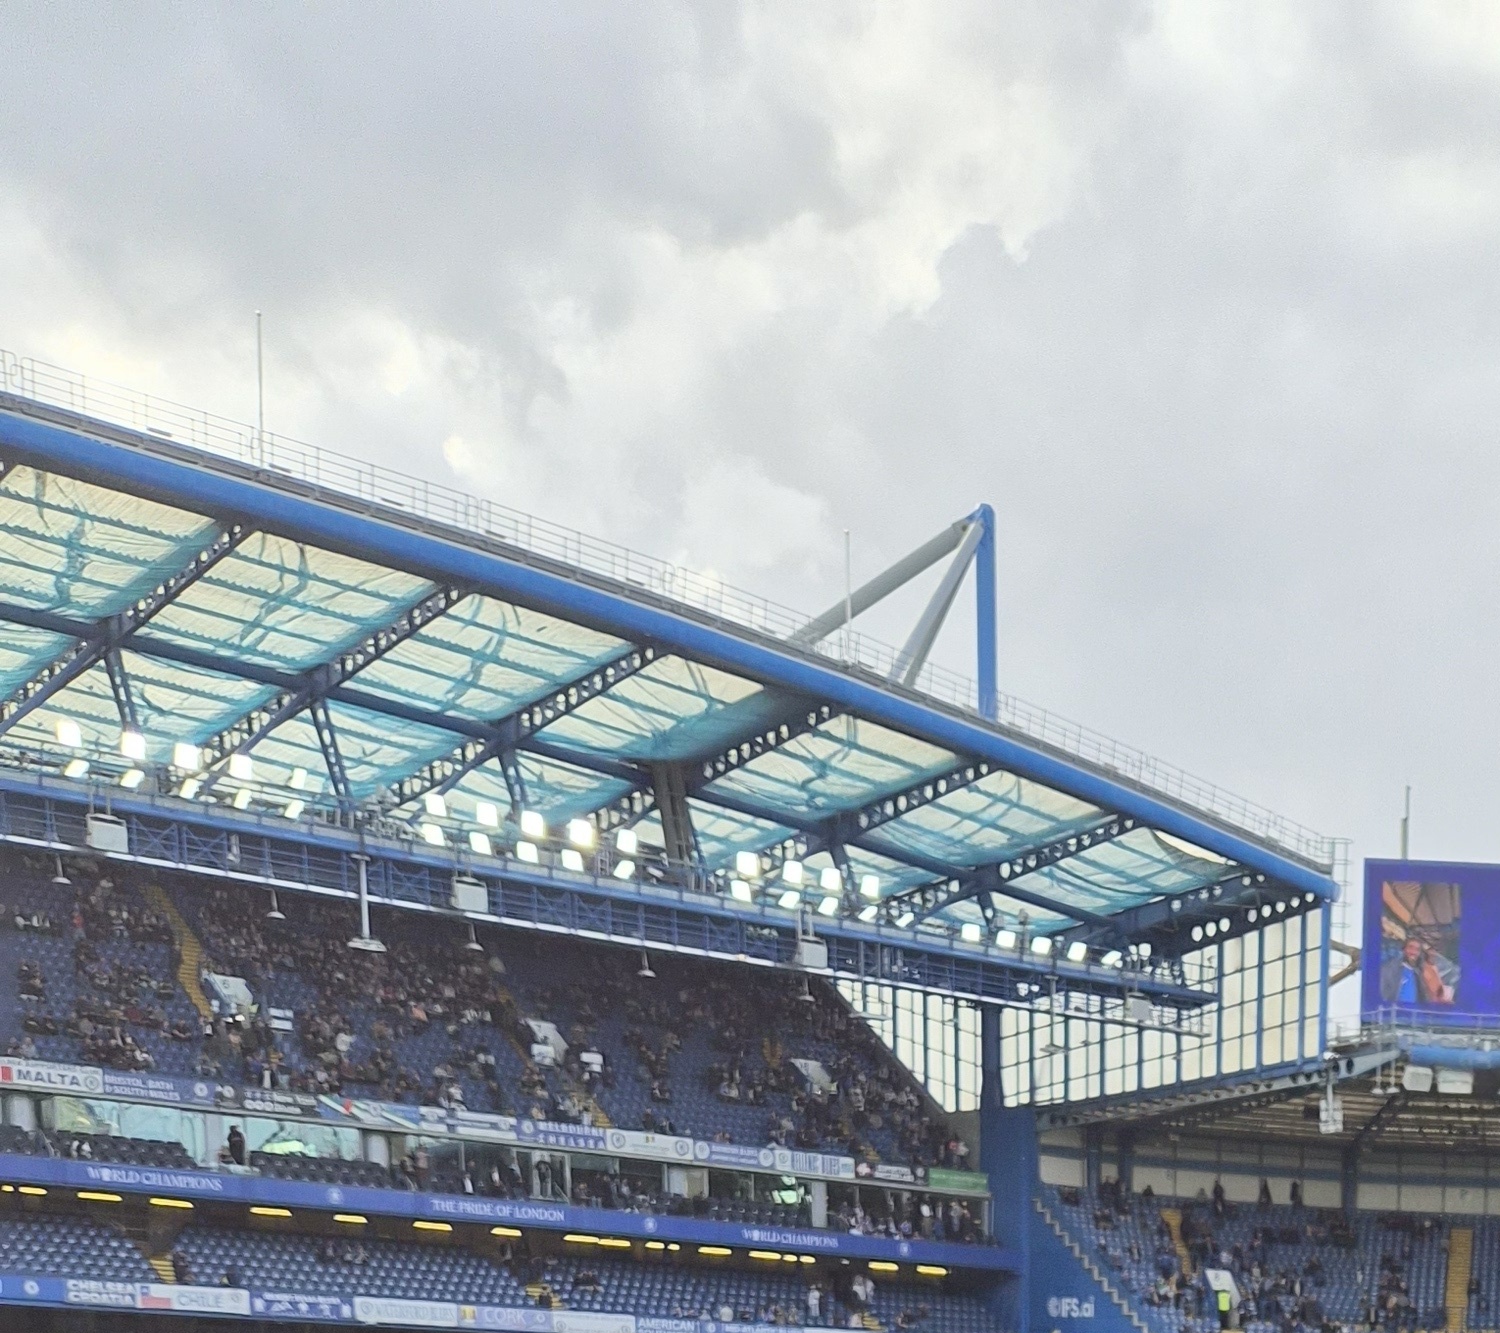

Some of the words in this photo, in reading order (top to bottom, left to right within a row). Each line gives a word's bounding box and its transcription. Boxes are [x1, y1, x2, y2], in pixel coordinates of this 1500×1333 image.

[17, 1069, 82, 1087] MALTA
[141, 1171, 223, 1191] CHAMPIONS
[431, 1199, 455, 1212] THE
[458, 1202, 494, 1216] PRIDE
[496, 1205, 514, 1217] OF
[515, 1207, 565, 1221] LONDON
[781, 1234, 838, 1248] CHAMPIONS
[67, 1279, 136, 1292] CHELSEA
[483, 1306, 527, 1324] CORK
[1060, 1296, 1095, 1318] IFS.ai
[638, 1317, 695, 1331] AMERICAN
